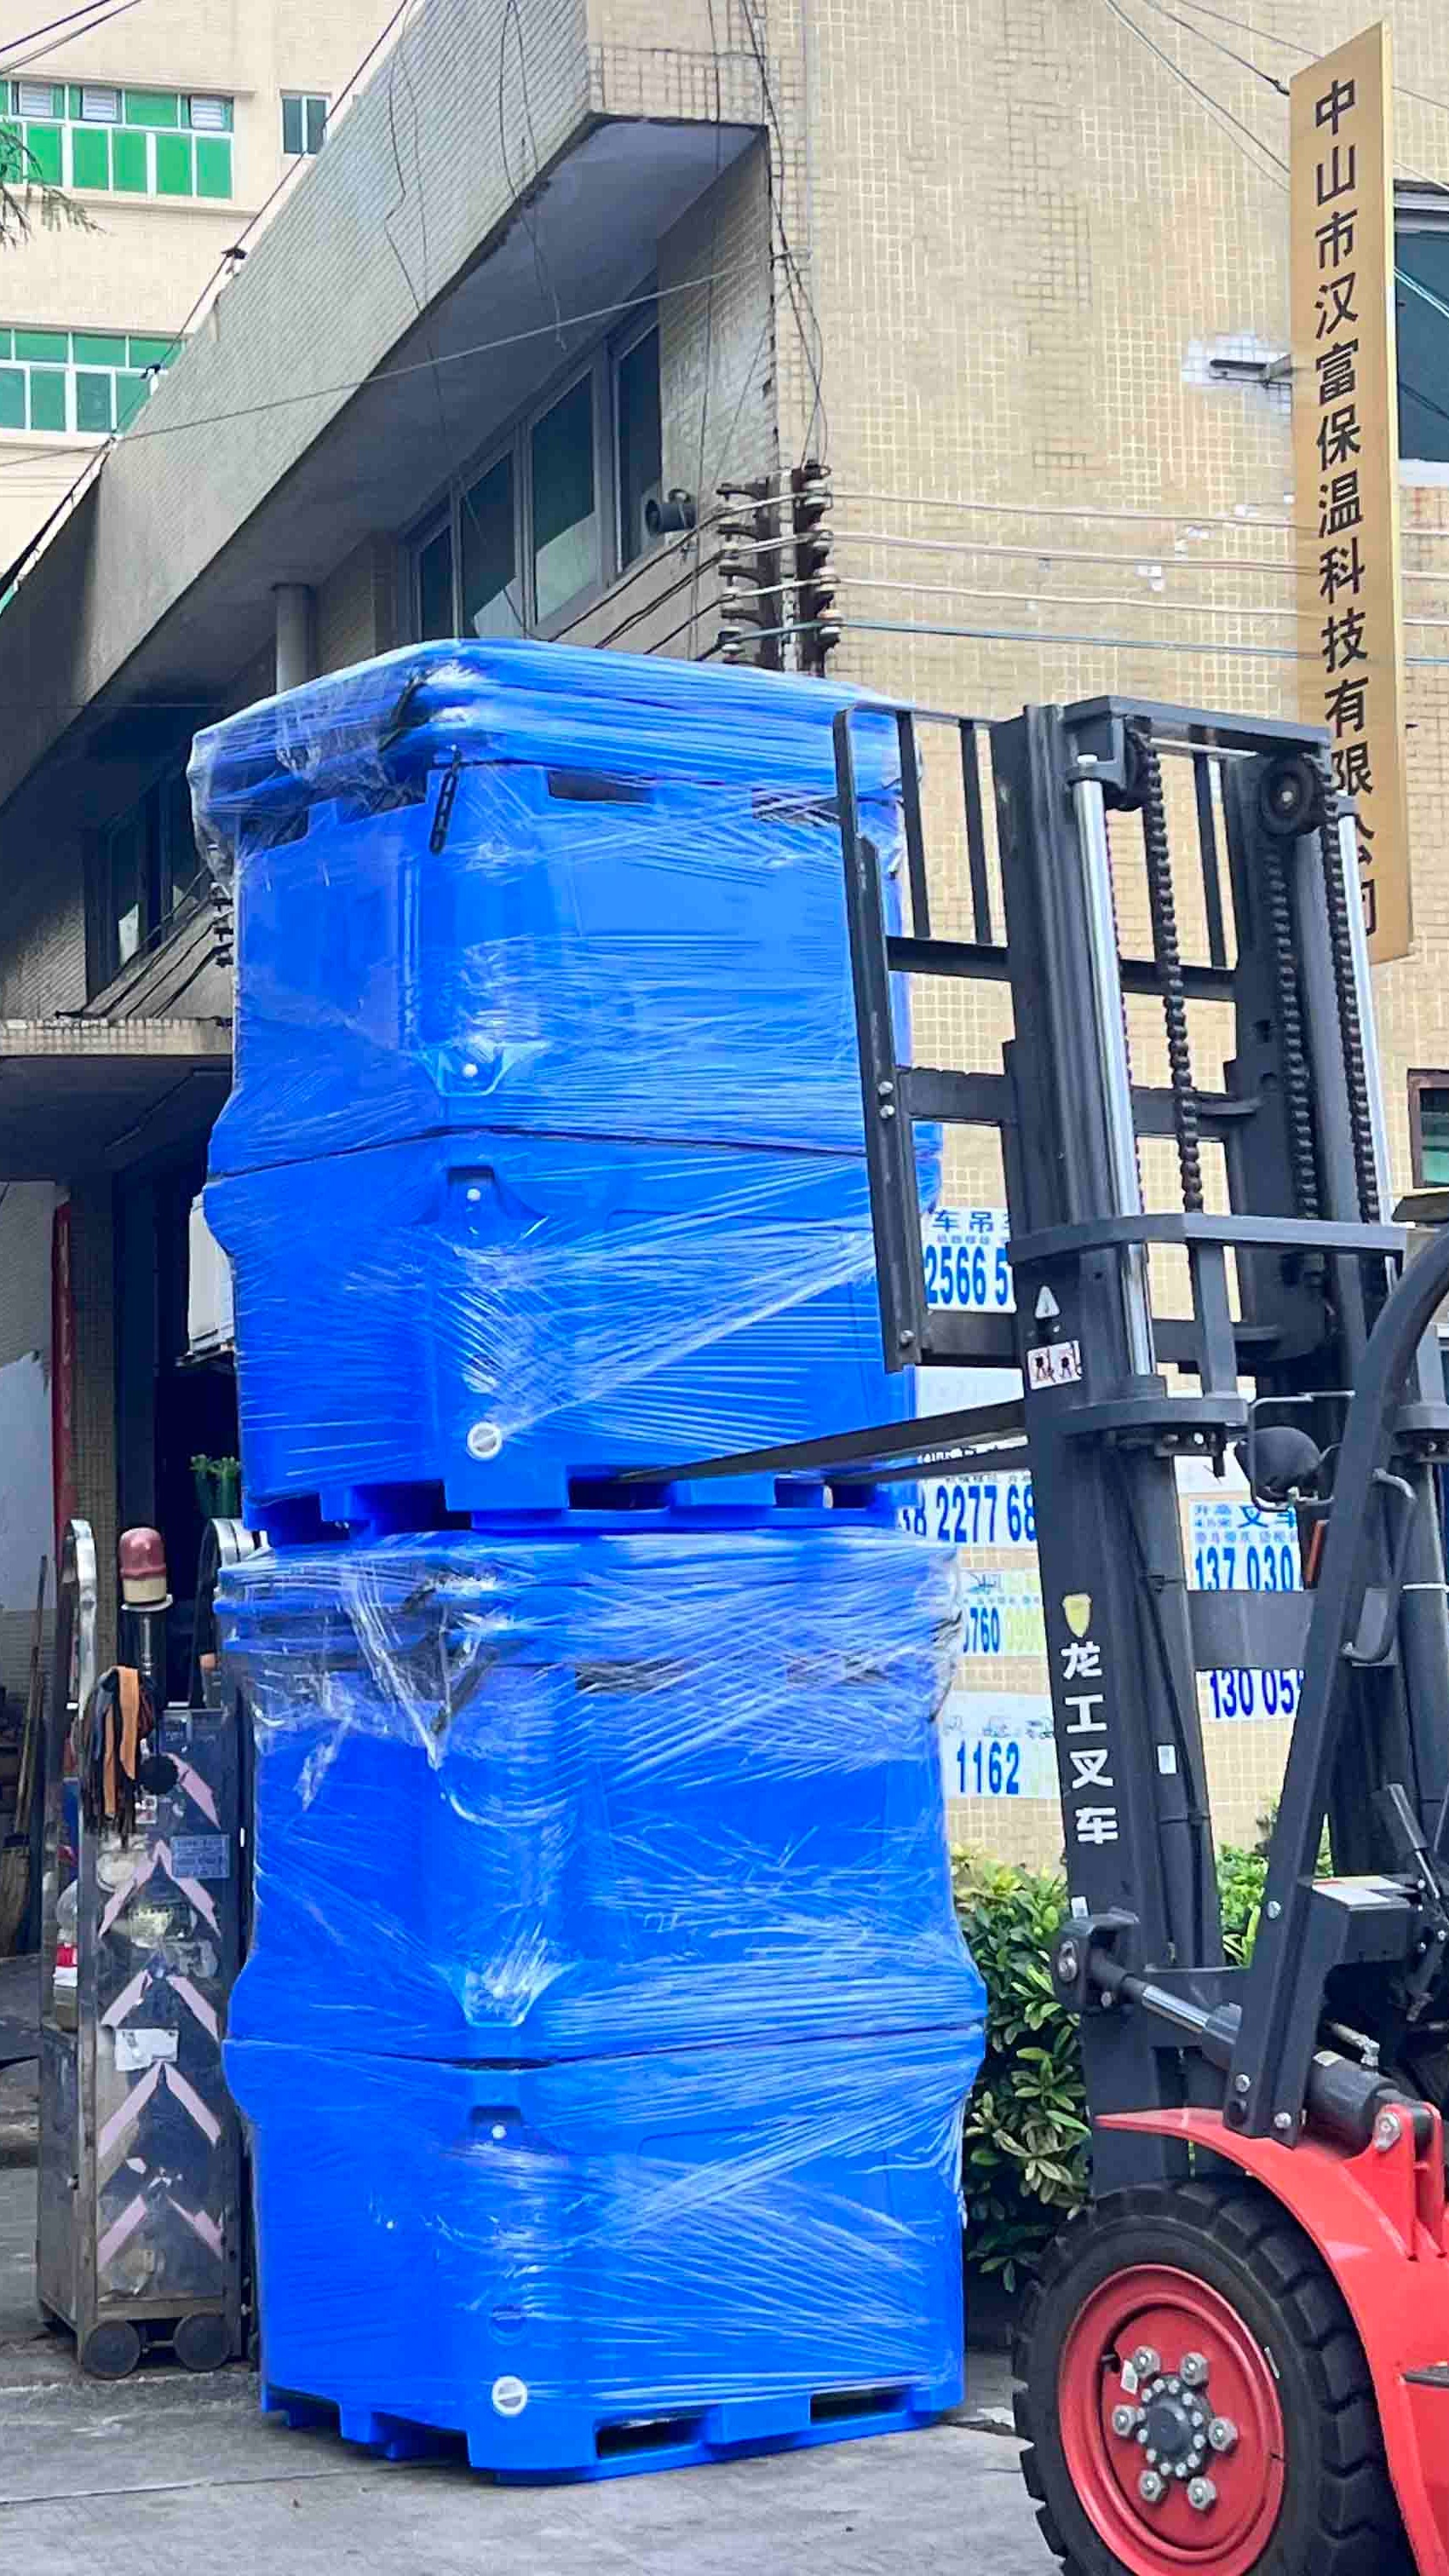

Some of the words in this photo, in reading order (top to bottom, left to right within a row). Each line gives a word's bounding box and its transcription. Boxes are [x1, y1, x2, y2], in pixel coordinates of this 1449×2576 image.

[932, 1209, 1010, 1233] 车吊
[937, 1485, 998, 1544] 2277
[1195, 1545, 1235, 1590] 137
[1246, 1544, 1294, 1590] 030
[1210, 1669, 1254, 1718] 130
[957, 1739, 1020, 1795] 1162
[1061, 1641, 1118, 1845] 龙工叉车
